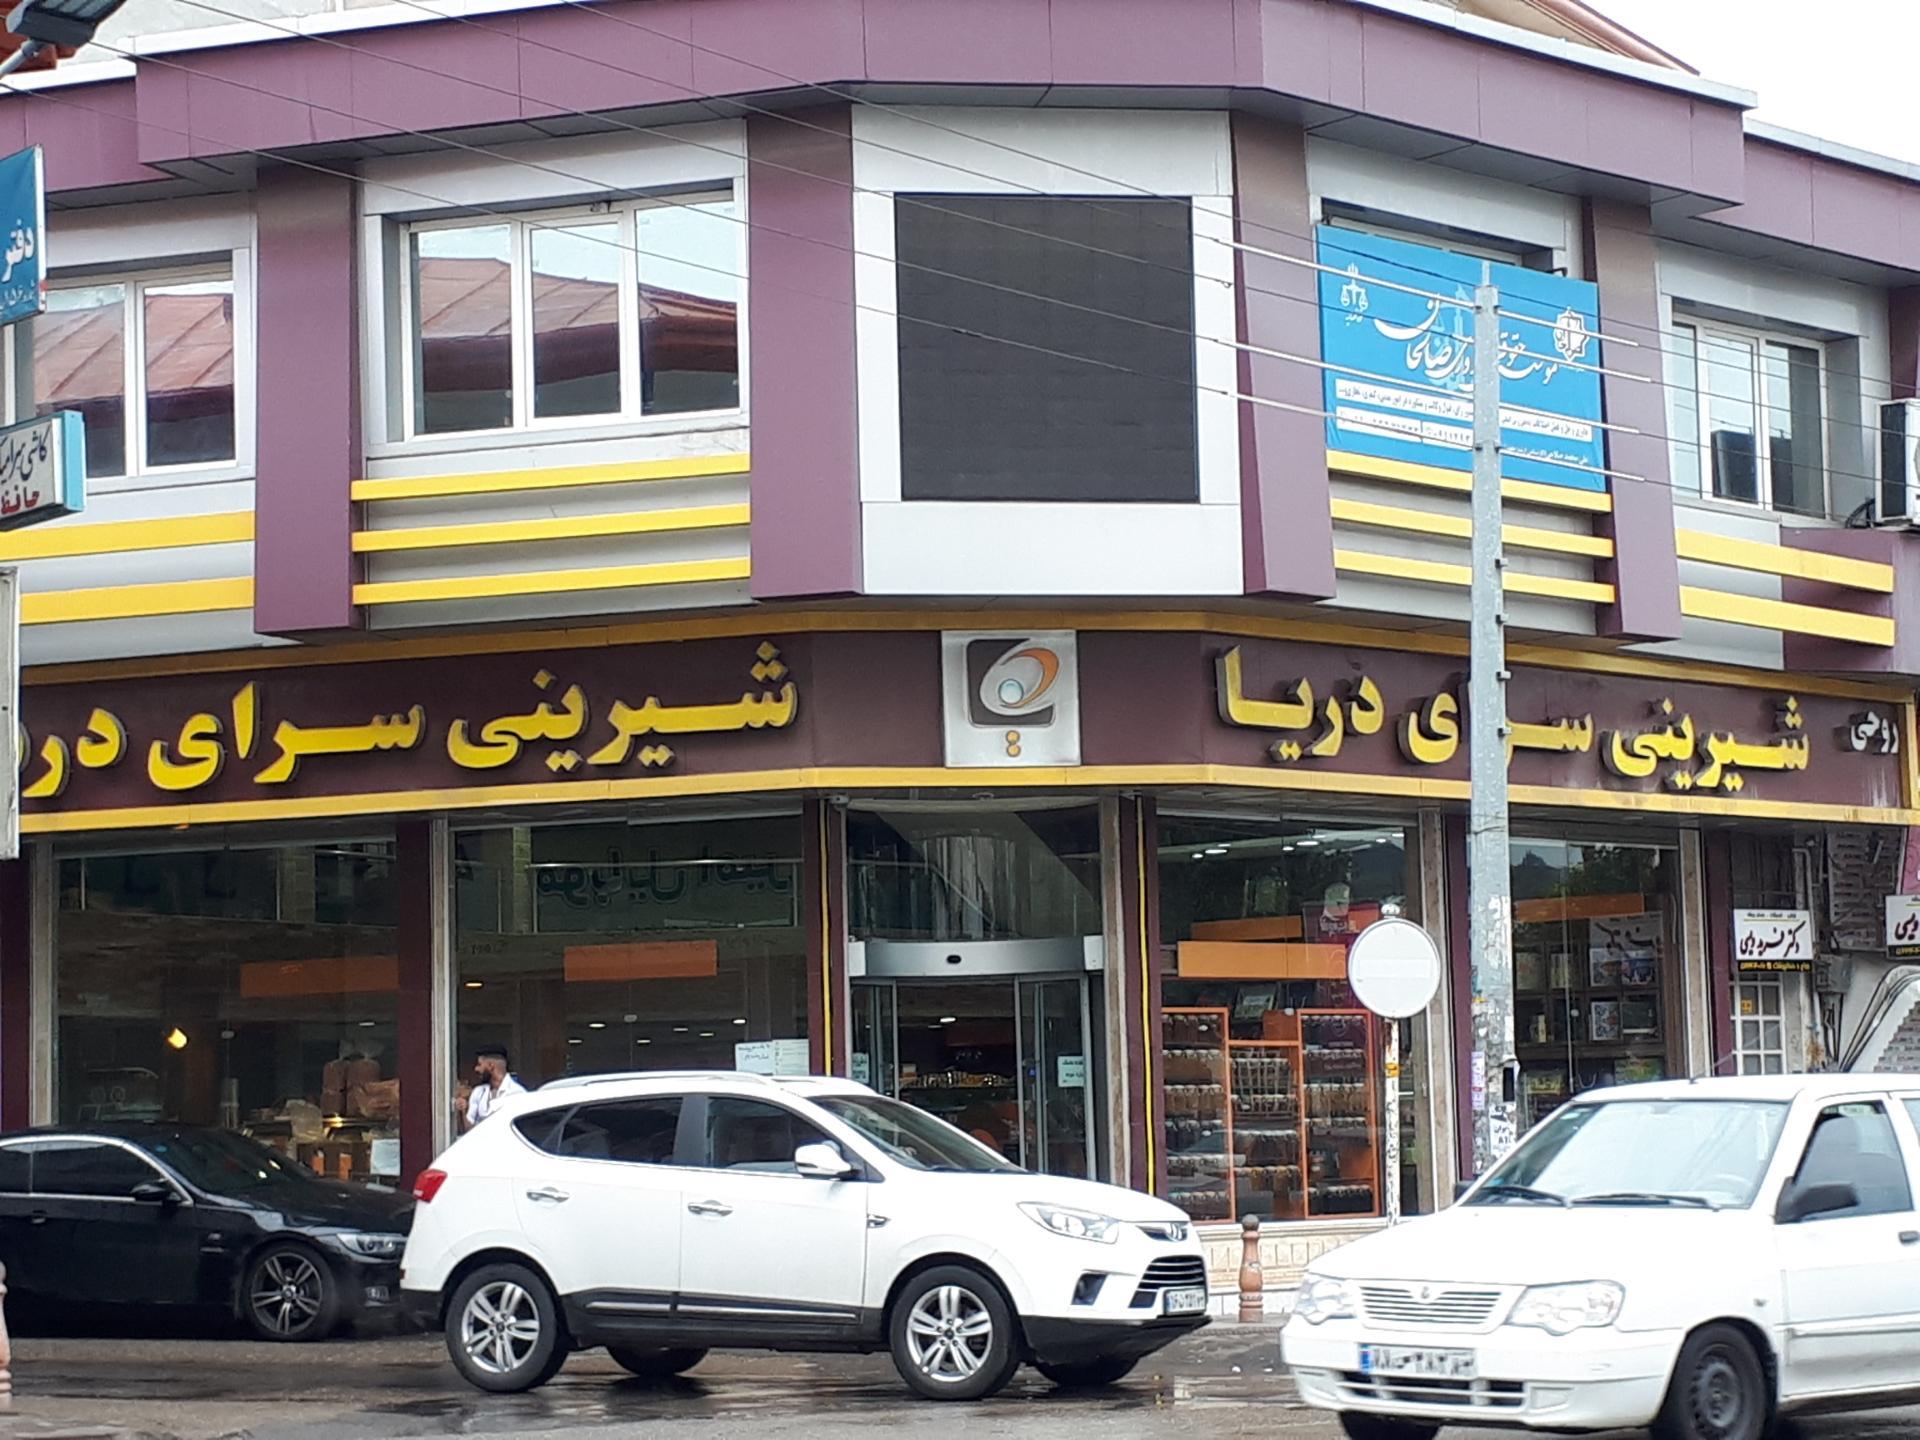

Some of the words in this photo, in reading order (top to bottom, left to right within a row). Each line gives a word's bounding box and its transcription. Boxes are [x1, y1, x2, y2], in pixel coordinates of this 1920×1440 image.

[1, 219, 34, 282] دفتر
[21, 424, 51, 482] کاشی
[148, 681, 425, 790] سرای
[448, 641, 799, 772] شیرینی
[1216, 644, 1386, 760] دریا
[1604, 695, 1809, 791] شیرینی
[16, 706, 127, 798] در
[1783, 920, 1807, 957] دکتر
